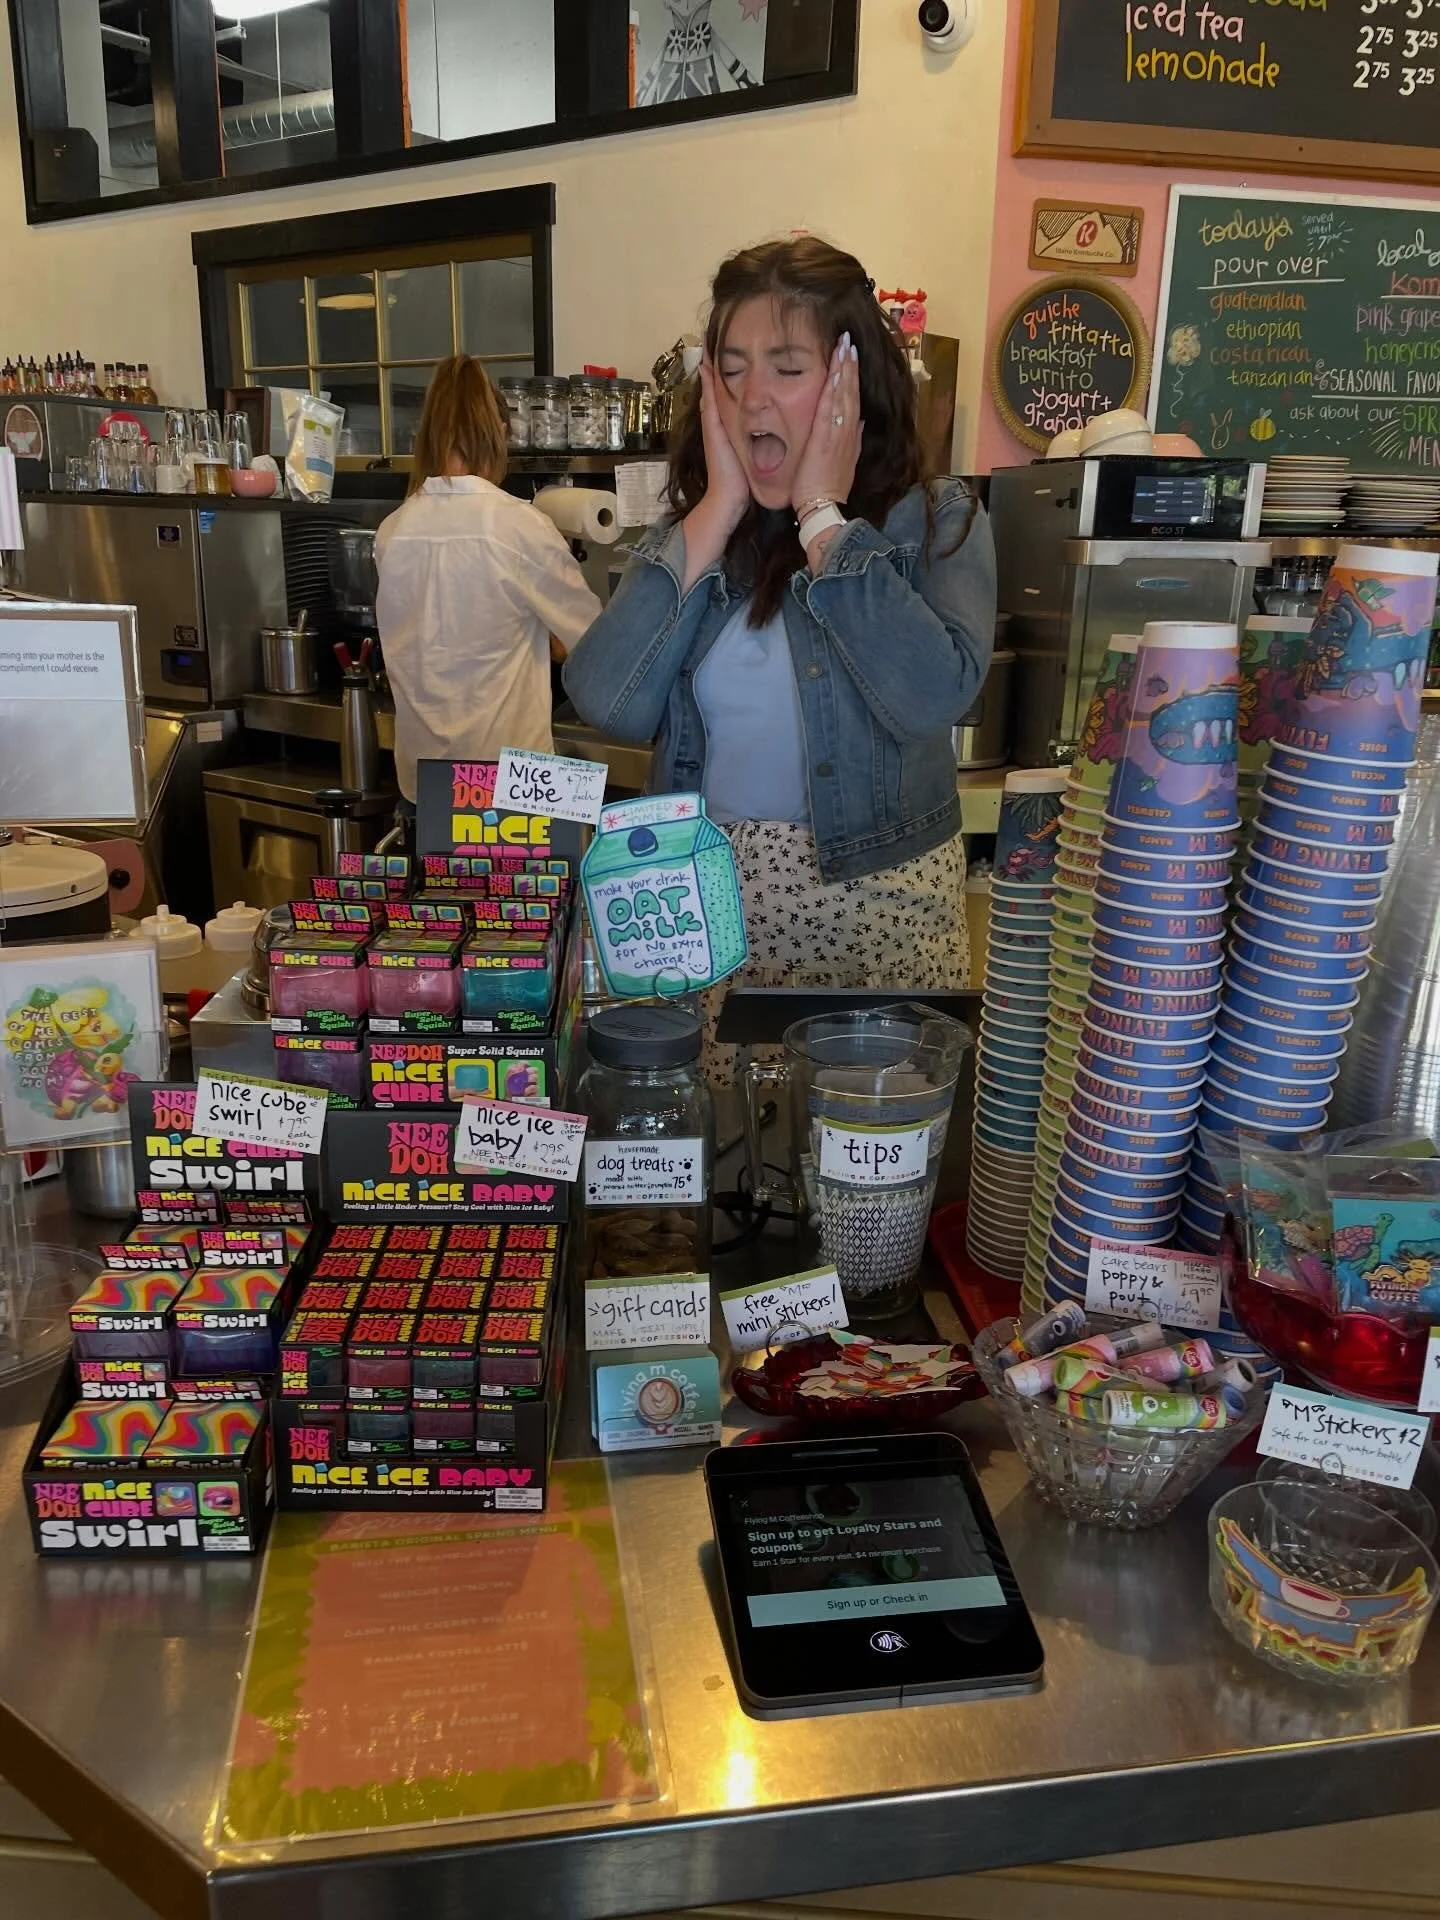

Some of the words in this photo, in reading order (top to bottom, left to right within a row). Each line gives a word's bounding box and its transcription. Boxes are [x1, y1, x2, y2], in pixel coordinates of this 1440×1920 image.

[1125, 0, 1187, 37] Iced
[1195, 2, 1245, 43] tea
[1125, 32, 1280, 88] lemonade
[1213, 256, 1269, 287] pour
[1276, 256, 1329, 278] over
[1023, 293, 1080, 340] quiche
[1356, 303, 1393, 333] pink
[1048, 320, 1133, 357] fritatta
[1226, 320, 1303, 346] ethiopian
[1011, 340, 1097, 369] breakfast
[1210, 345, 1261, 368] costa
[1019, 365, 1093, 391] burrito
[1227, 369, 1314, 388] tanzanian
[1330, 368, 1397, 393] SEASONAL
[1033, 386, 1100, 417] yogurt
[1290, 405, 1315, 420] ask
[1320, 404, 1359, 420] about
[1368, 407, 1397, 422] our
[57, 651, 83, 660] mother
[85, 652, 91, 660] is
[93, 651, 105, 660] the
[51, 664, 71, 673] could
[509, 761, 552, 785] Nice
[593, 884, 622, 899] make
[627, 878, 651, 895] your
[656, 873, 690, 886] drink
[607, 886, 691, 926] OAT
[615, 948, 637, 961] for
[672, 940, 704, 950] extra
[22, 1010, 50, 1022] THE
[62, 1008, 97, 1022] BEST
[9, 1022, 25, 1033] OF
[34, 1026, 54, 1036] ME
[15, 1052, 56, 1063] FROM
[447, 1045, 477, 1056] Super
[478, 1046, 505, 1056] Solid
[506, 1046, 545, 1057] Squish!
[212, 1081, 252, 1102] nice
[261, 1092, 307, 1115] cube
[372, 1082, 445, 1103] CUBE
[209, 1103, 262, 1130] swirl
[478, 1104, 521, 1126] nice
[527, 1112, 556, 1135] ice
[468, 1126, 524, 1158] baby
[618, 1145, 659, 1154] housemade
[389, 1144, 449, 1175] DOH
[597, 1154, 625, 1177] dog
[630, 1157, 674, 1172] treats
[843, 1138, 903, 1175] tips
[149, 1159, 304, 1191] Swirl
[203, 1250, 284, 1266] Swirl
[1101, 1255, 1129, 1270] care
[1133, 1257, 1168, 1273] bears
[1101, 1269, 1148, 1290] poppy
[1152, 1276, 1164, 1288] &
[744, 1293, 779, 1314] free
[1109, 1291, 1150, 1309] pout
[1370, 1290, 1420, 1302] COFFEE
[601, 1295, 646, 1327] gift
[650, 1290, 707, 1318] cards
[736, 1315, 772, 1335] mini
[776, 1284, 838, 1323] stickers!
[1314, 1414, 1396, 1445] Stickers
[289, 1441, 330, 1461] DOH
[39, 1518, 199, 1548] Swirl
[520, 1525, 559, 1537] MENU
[748, 1531, 776, 1544] Sign
[780, 1530, 795, 1541] up
[797, 1529, 811, 1538] to
[814, 1527, 835, 1539] get
[837, 1522, 881, 1537] Loyalty
[884, 1521, 917, 1531] Stars
[919, 1517, 943, 1528] and
[750, 1543, 804, 1556] coupons
[753, 1559, 772, 1567] Earn
[780, 1557, 797, 1566] Star
[812, 1555, 835, 1564] every
[827, 1599, 851, 1611] Sign
[853, 1599, 867, 1609] up
[869, 1597, 880, 1606] or
[882, 1593, 915, 1605] Check
[919, 1592, 929, 1601] in
